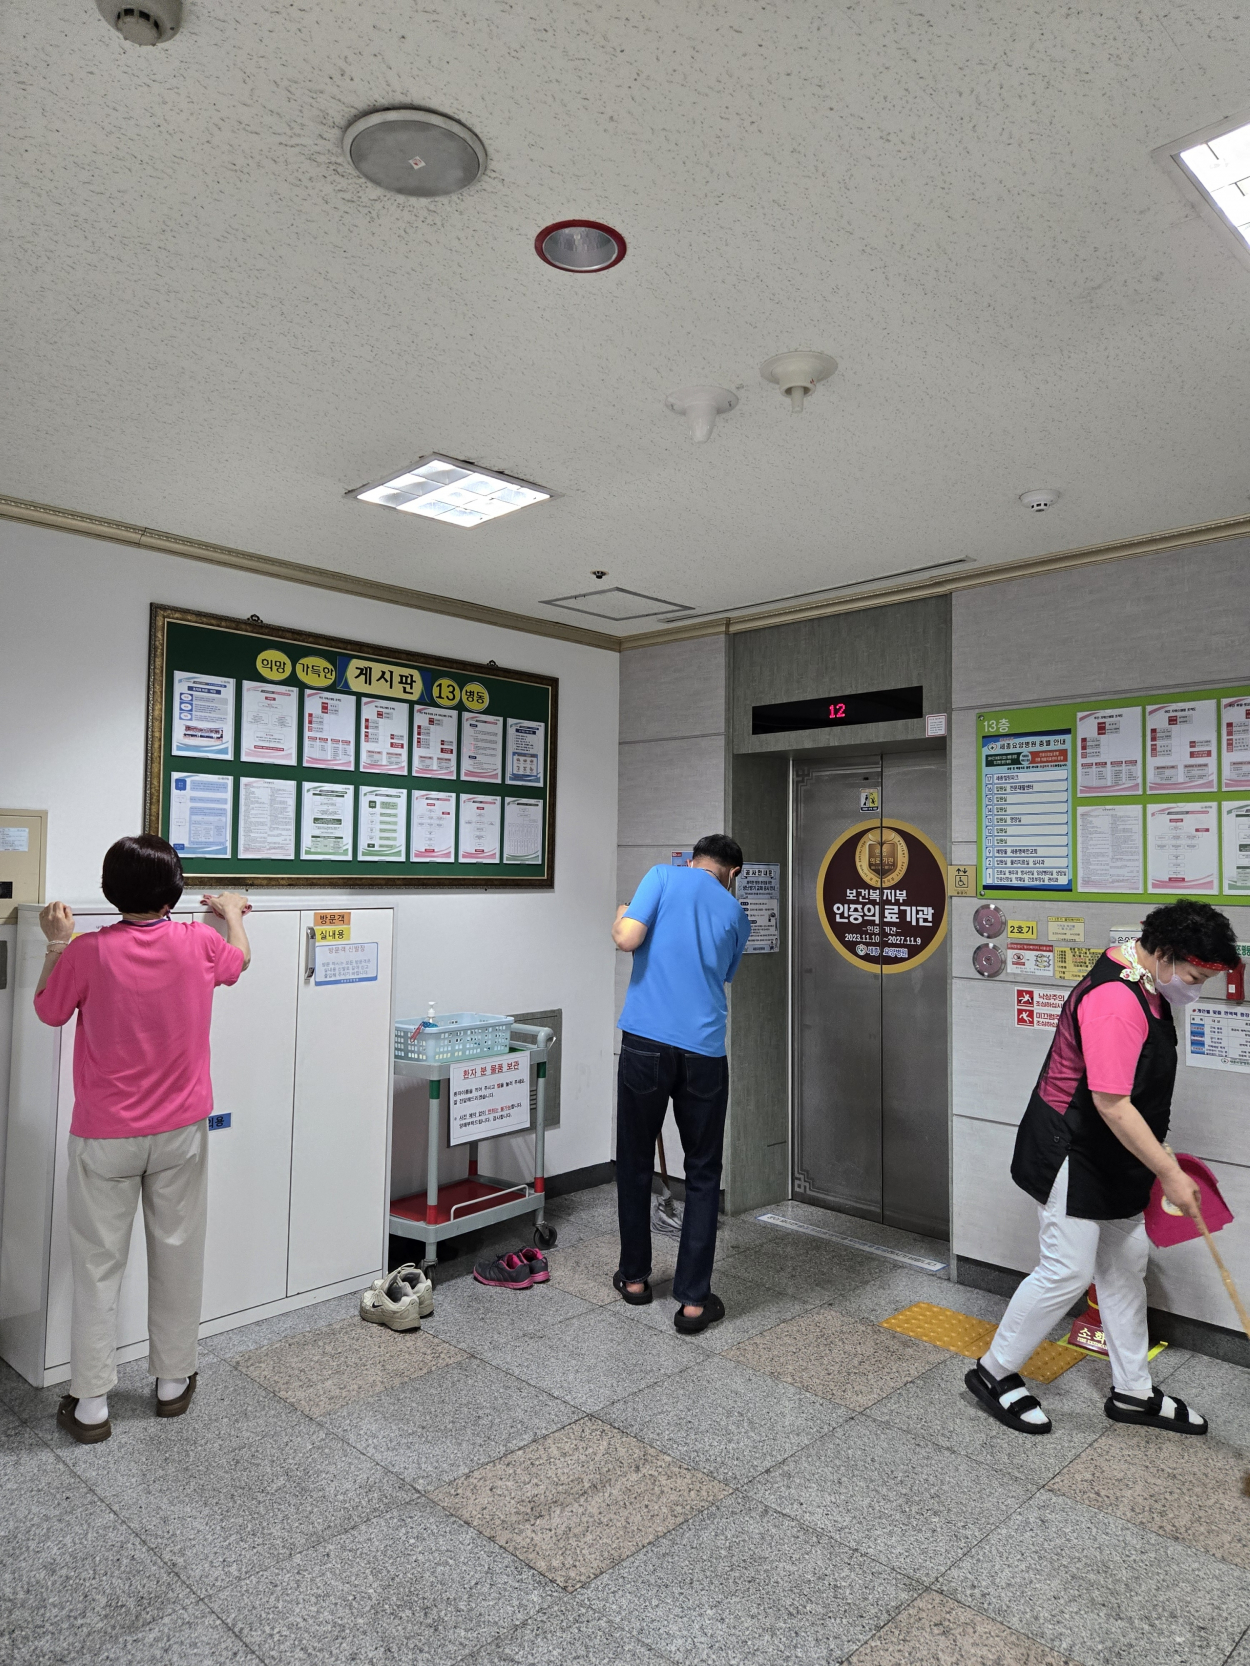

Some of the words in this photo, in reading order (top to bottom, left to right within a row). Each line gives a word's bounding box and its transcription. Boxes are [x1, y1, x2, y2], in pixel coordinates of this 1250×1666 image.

[261, 658, 286, 674] 희망
[298, 661, 334, 680] 가득한
[354, 666, 416, 694] 게시판
[436, 683, 456, 700] 13
[465, 688, 486, 704] 병동
[829, 704, 846, 718] 12
[1000, 740, 1036, 750] 세종요양병원
[1038, 739, 1050, 747] 층별
[846, 889, 907, 903] 보건복지부
[320, 914, 345, 924] 방문객
[833, 903, 935, 926] 인증의료기관
[320, 929, 345, 940] 실내용
[1010, 925, 1034, 935] 2호기
[1038, 993, 1064, 1002] 낙상주의
[463, 1068, 476, 1079] 환자
[480, 1066, 487, 1076] 분
[490, 1063, 503, 1074] 물품
[507, 1061, 519, 1070] 보관
